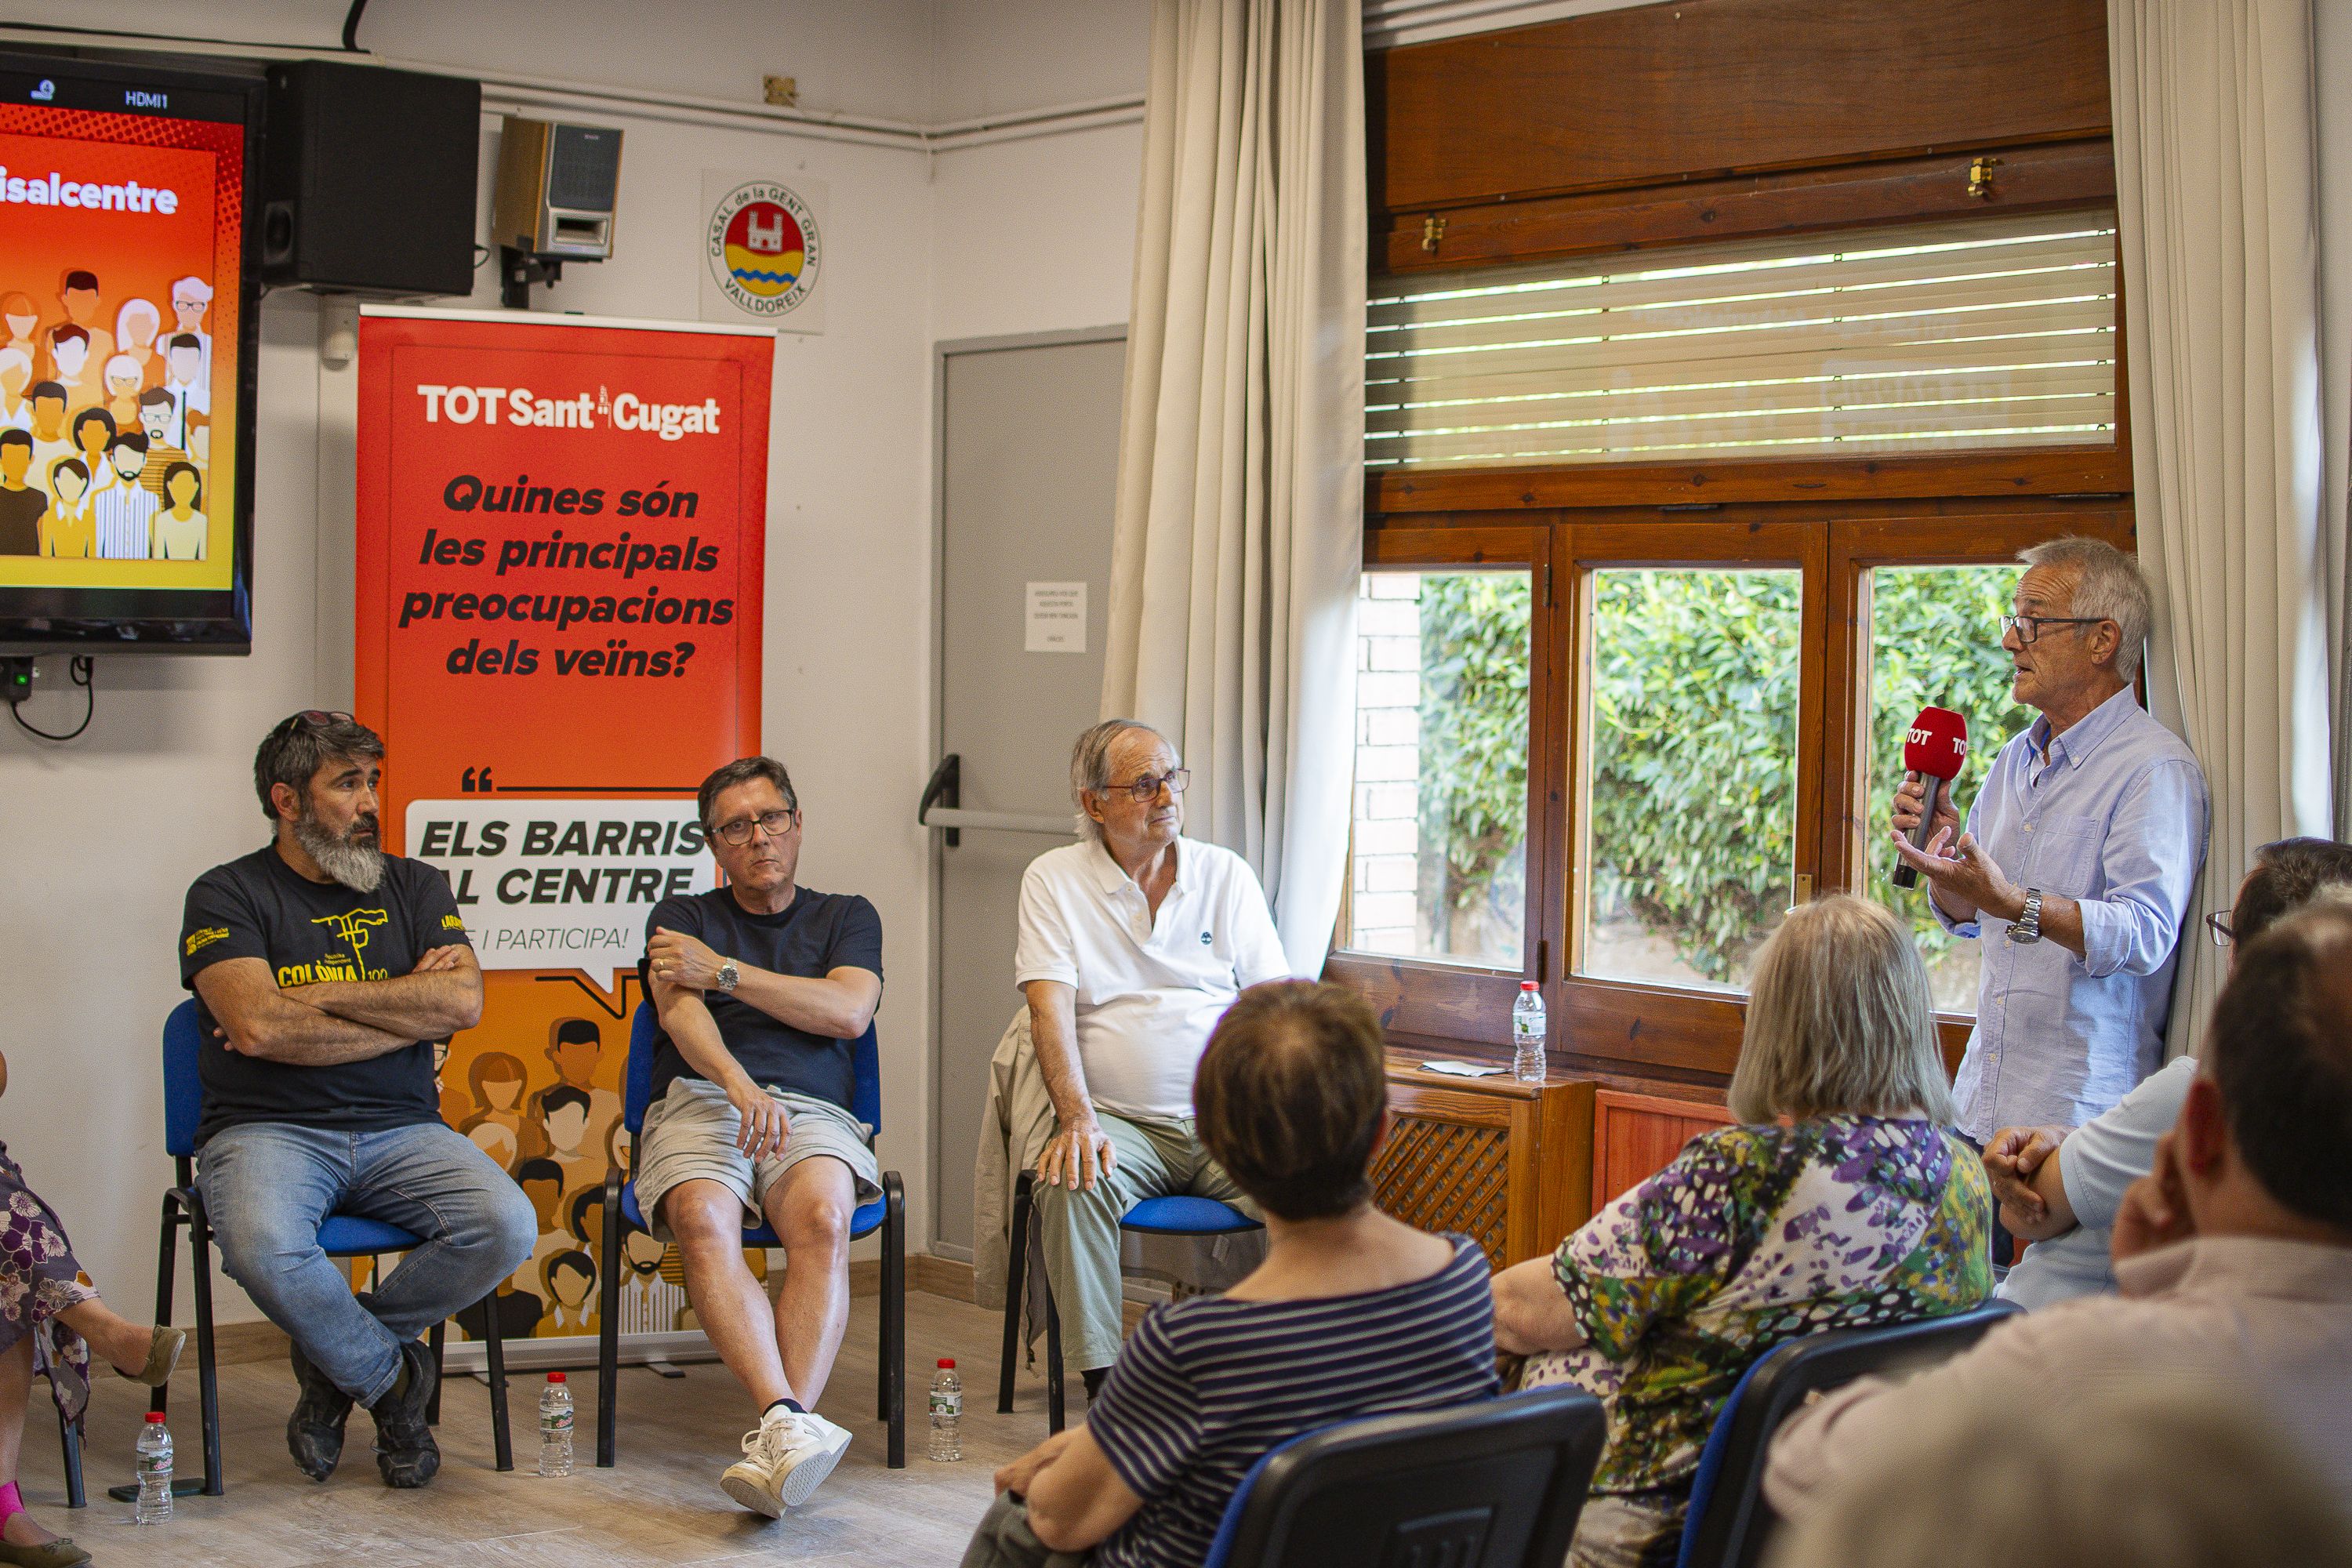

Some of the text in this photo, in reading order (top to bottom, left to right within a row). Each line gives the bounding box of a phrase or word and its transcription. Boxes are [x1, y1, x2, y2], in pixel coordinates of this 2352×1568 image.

[125, 90, 168, 109] HDMI1
[711, 186, 817, 267] CASAL de la GENT GRAN
[724, 277, 806, 313] VALLDOREIX
[417, 384, 720, 441] TOT Sant Cugat
[442, 474, 699, 518] Quines són
[418, 528, 720, 579] les principals
[398, 586, 735, 632] preocupacions
[445, 638, 696, 678] dels veïns?
[1907, 728, 1933, 746] TOT
[419, 820, 706, 857] ELS BARRIS
[439, 868, 695, 905] L CENTRE
[495, 927, 629, 950] PARTICIPA!
